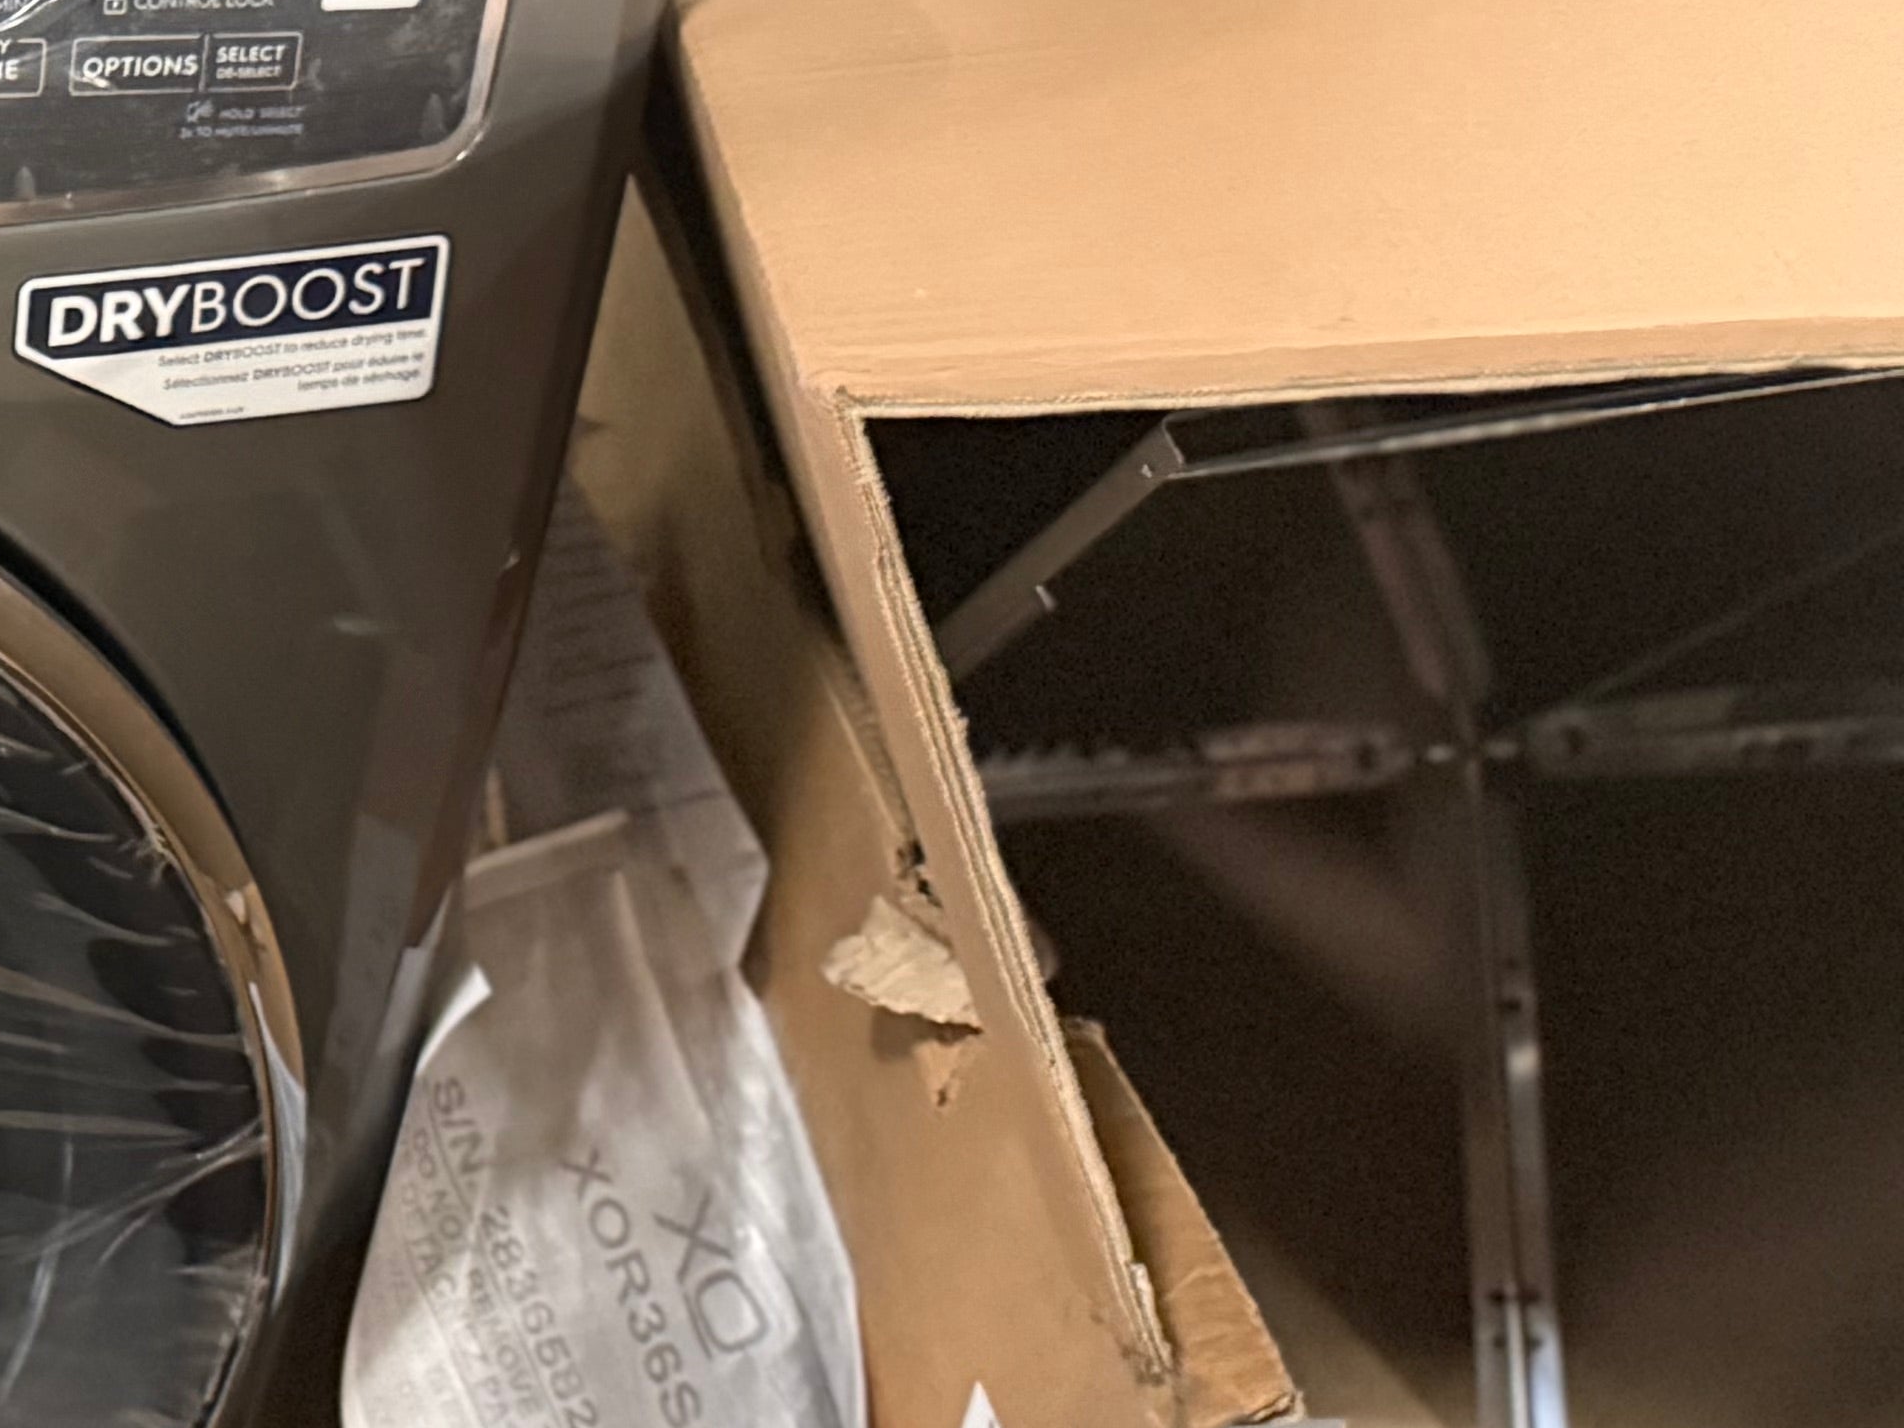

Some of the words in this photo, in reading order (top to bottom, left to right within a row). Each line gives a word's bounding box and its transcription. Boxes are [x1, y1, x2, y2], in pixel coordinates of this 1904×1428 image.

[216, 44, 286, 63] SELECT
[82, 55, 198, 78] OPTIONS
[47, 257, 428, 349] DRYBOOST
[203, 343, 282, 364] DRYBOOST
[651, 1184, 772, 1361] XO
